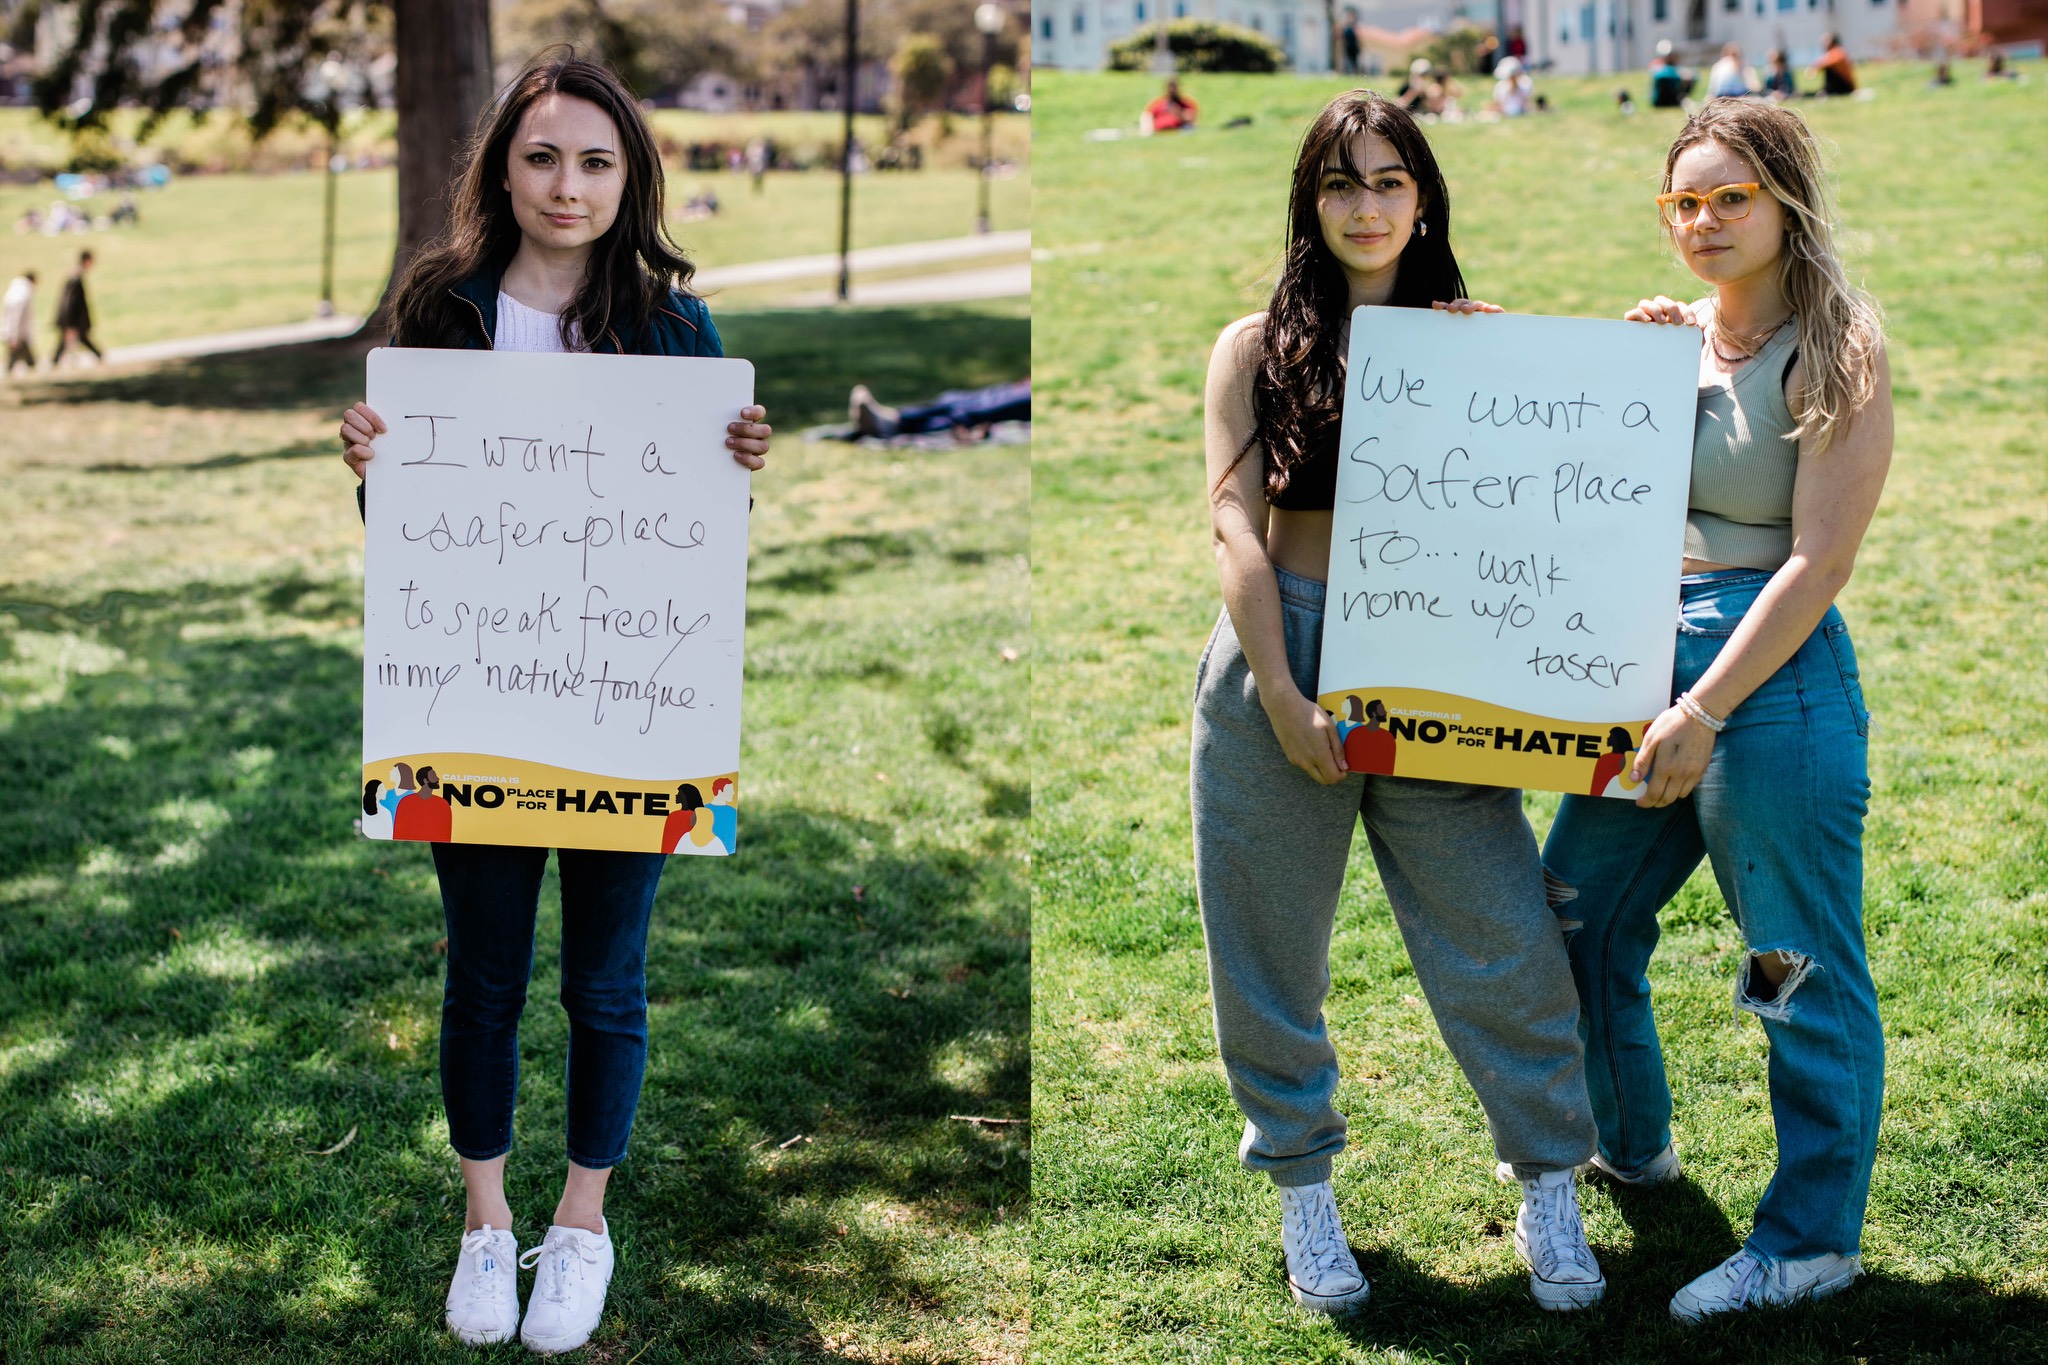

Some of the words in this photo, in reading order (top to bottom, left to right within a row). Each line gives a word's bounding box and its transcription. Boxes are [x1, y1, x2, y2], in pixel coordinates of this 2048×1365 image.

[1360, 356, 1432, 408] We
[1467, 391, 1601, 434] want
[1621, 400, 1660, 433] a
[402, 415, 468, 469] I
[482, 424, 606, 499] want
[641, 440, 677, 475] a
[1345, 436, 1539, 510] Safer
[402, 501, 560, 565] safer
[562, 508, 706, 582] place
[1477, 549, 1571, 598] walk
[399, 580, 434, 631] to
[443, 591, 562, 665] speak
[566, 584, 711, 682] freely
[1471, 593, 1536, 640] w/o
[1565, 610, 1596, 635] a
[1526, 646, 1640, 690] taser
[378, 652, 401, 688] in
[407, 662, 462, 727] my
[486, 658, 585, 698] native
[1388, 716, 1448, 745] NO
[1389, 707, 1450, 720] CALIFORNIA
[1451, 713, 1462, 721] IS
[1448, 723, 1495, 737] PLACE
[1456, 736, 1486, 748] FOR
[1493, 725, 1603, 760] HATE
[442, 773, 508, 784] CALIFORNIA
[509, 776, 520, 784] IS
[442, 783, 506, 809] NO
[506, 787, 556, 799] PLACE
[516, 800, 548, 811] FOR
[555, 787, 671, 818] HATE
